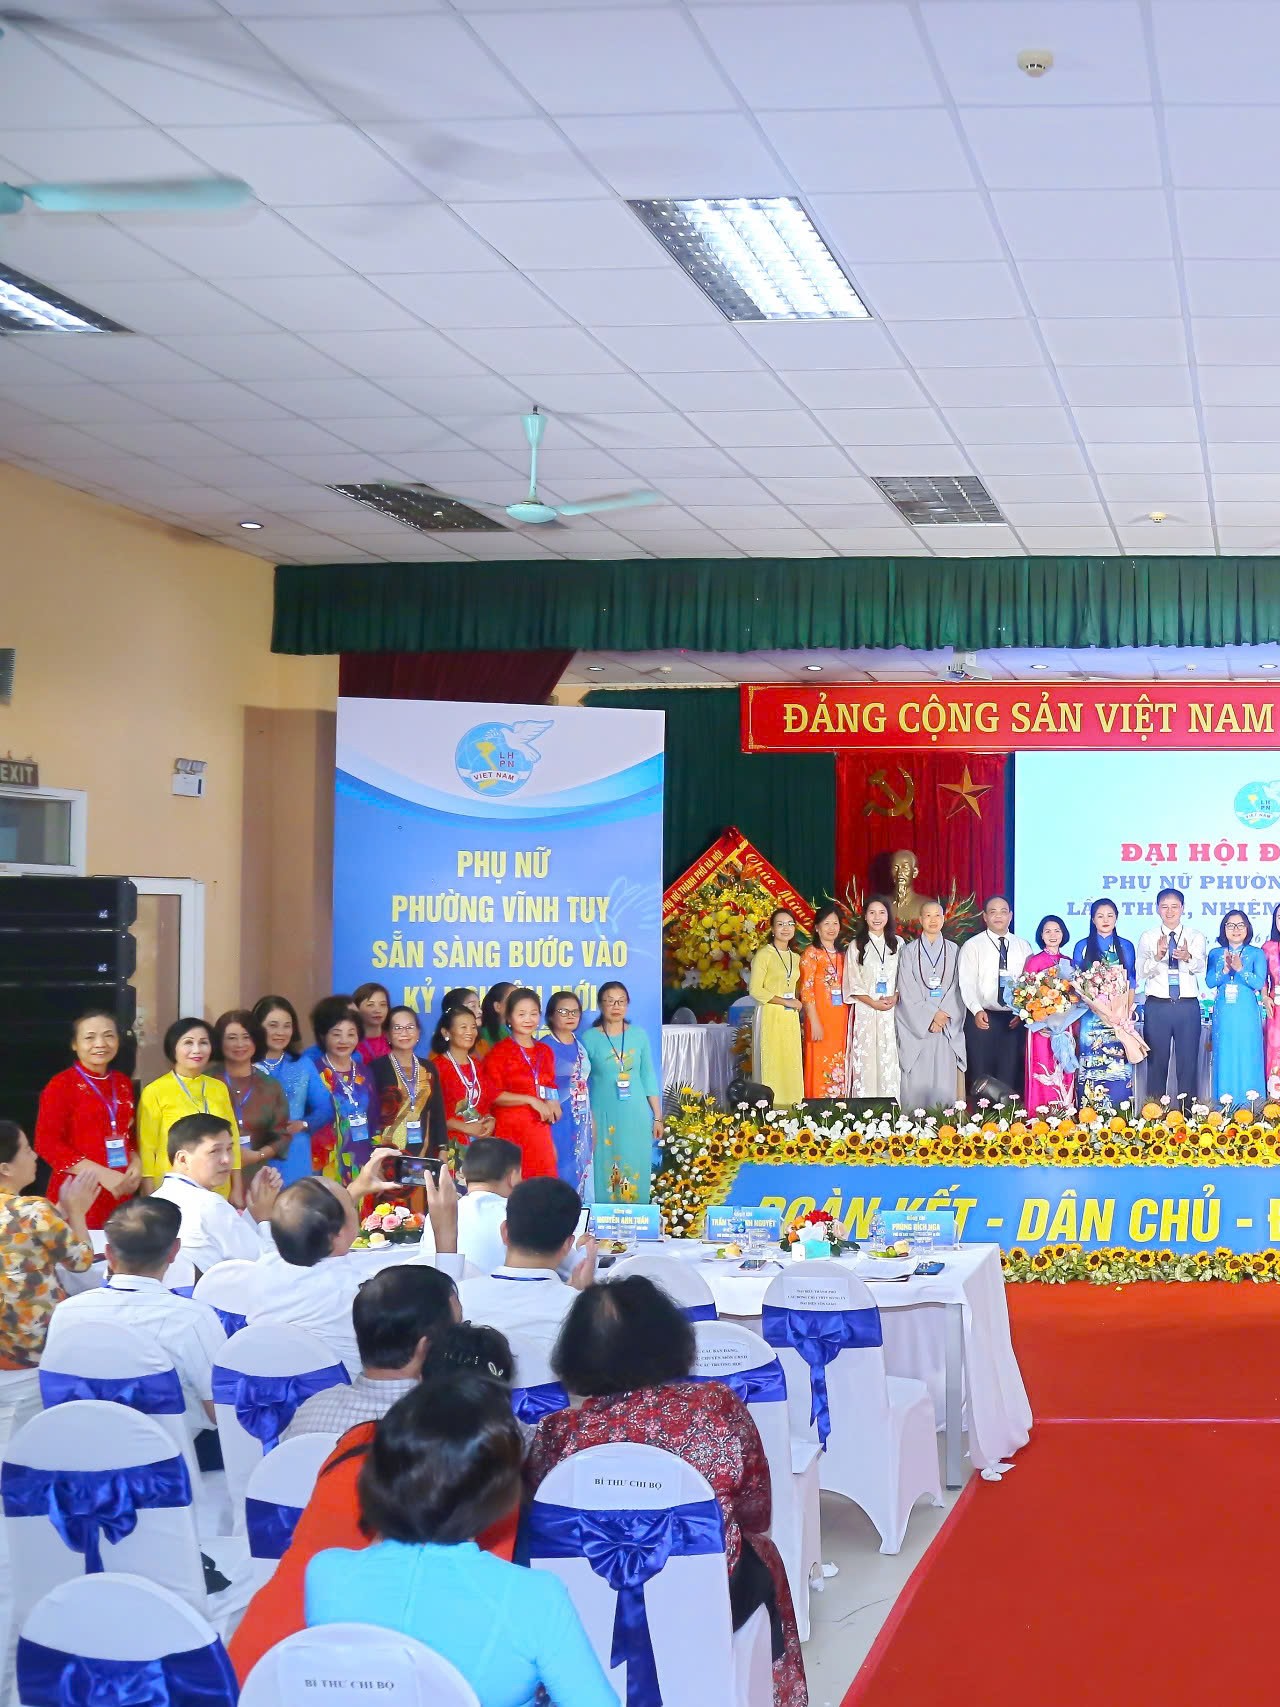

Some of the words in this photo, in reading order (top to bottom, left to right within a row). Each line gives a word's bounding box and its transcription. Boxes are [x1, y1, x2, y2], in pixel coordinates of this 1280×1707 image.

[783, 692, 887, 733] ĐẢNG
[898, 693, 1000, 742] CỘNG
[1010, 691, 1084, 733] SẢN
[1094, 694, 1177, 742] VIỆT
[1187, 703, 1274, 733] NAM
[1, 763, 33, 783] EXIT
[496, 772, 515, 781] NAM
[457, 850, 506, 884] PHỤ
[514, 846, 551, 879] NỮ
[1121, 843, 1178, 866] ĐẠI
[1189, 838, 1248, 866] HỘI
[679, 875, 698, 894] THÀNH
[695, 863, 708, 881] PHỐ
[1102, 875, 1151, 893] PHỤ
[1159, 872, 1193, 890] NỮ
[391, 888, 494, 923] PHƯỜNG
[503, 891, 559, 923] VĨNH
[566, 896, 610, 923] TUY
[372, 930, 424, 969] SẴN
[433, 936, 501, 969] SÀNG
[509, 935, 574, 969] BƯỚC
[581, 936, 628, 968] VÀO
[404, 977, 435, 1014] KỶ
[1016, 1188, 1115, 1243] DÂN
[1129, 1184, 1221, 1243] CHỦ
[608, 1479, 627, 1487] THƯ
[629, 1480, 646, 1488] CHI
[350, 1680, 373, 1689] CHI
